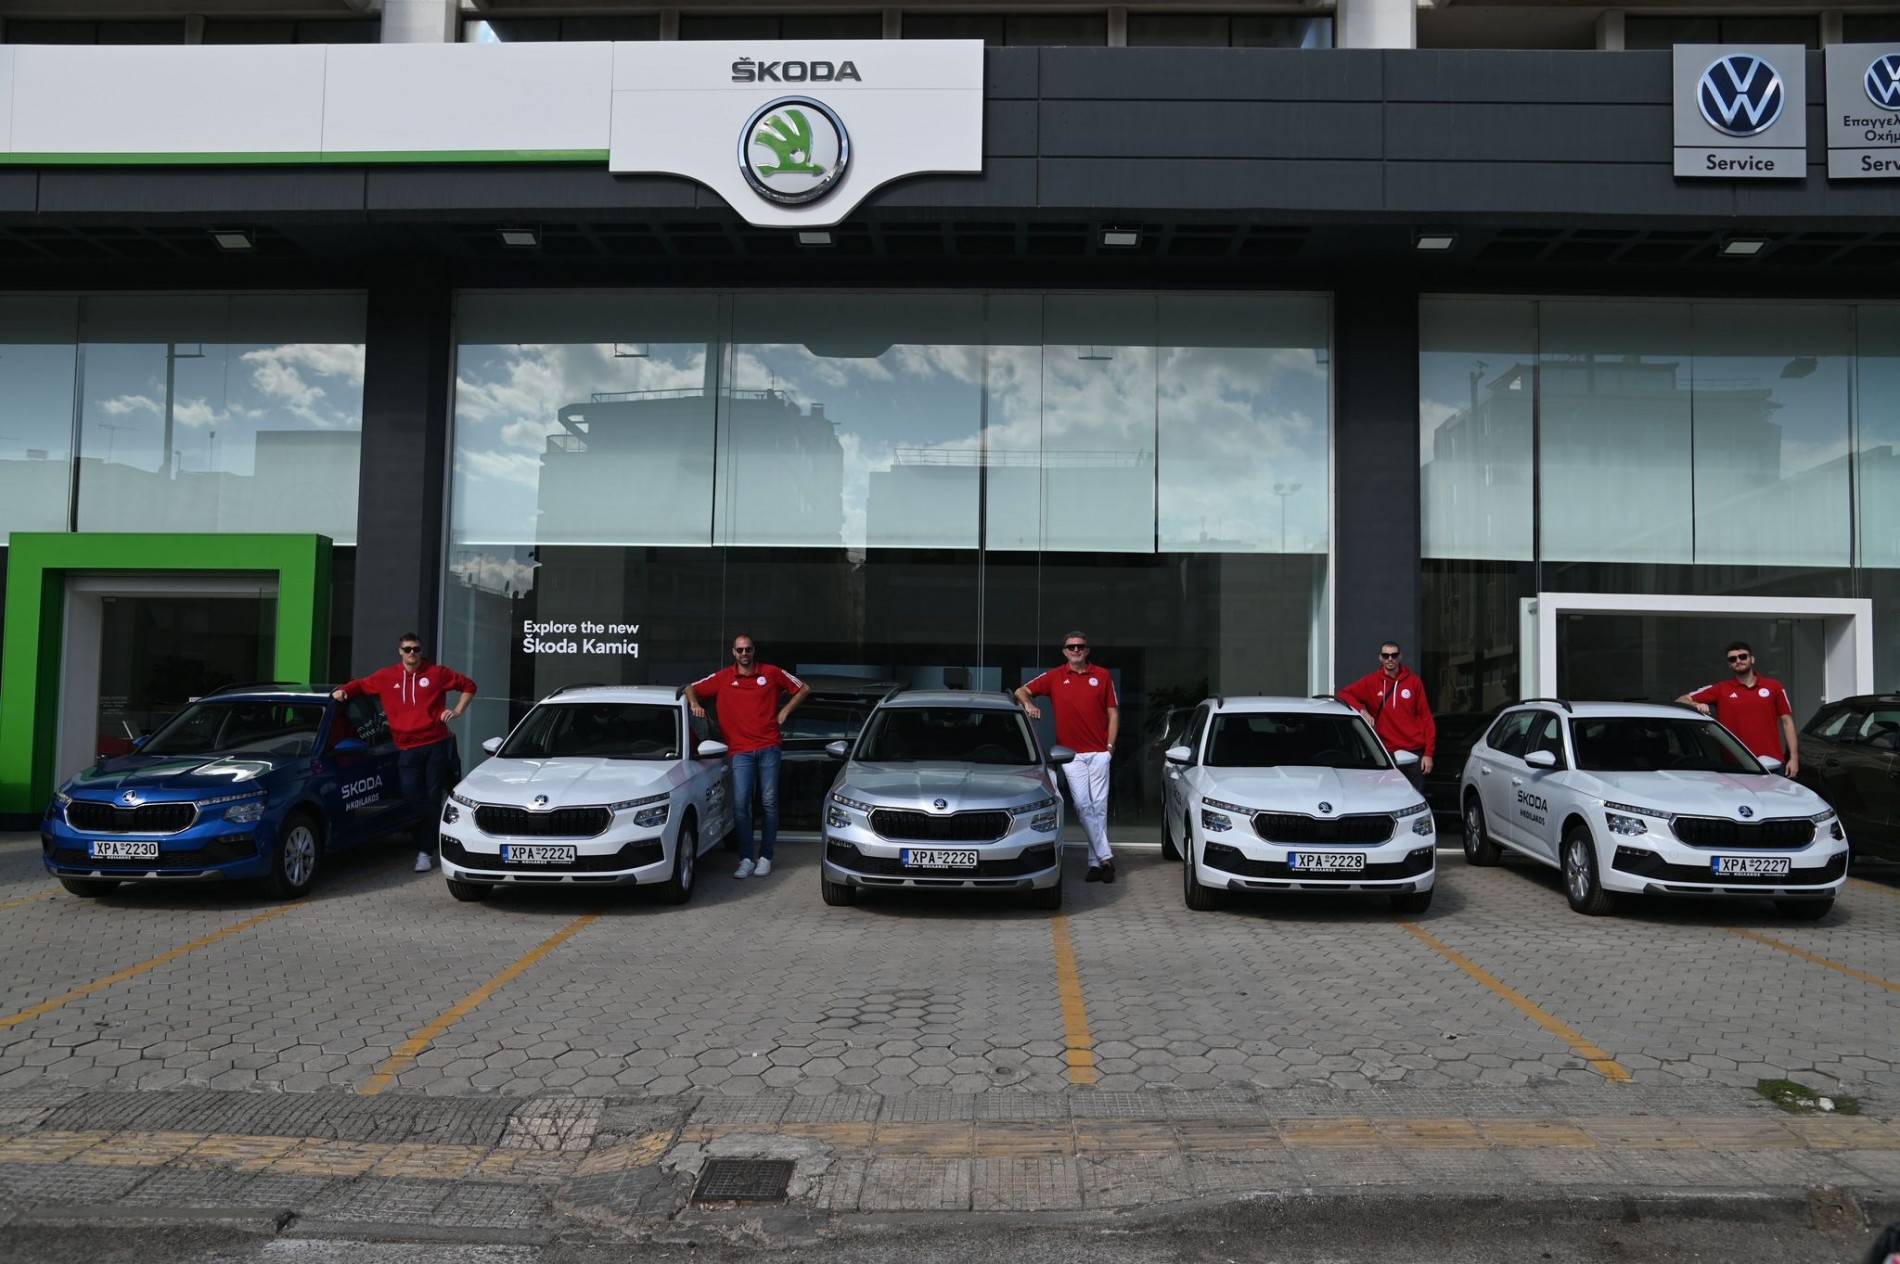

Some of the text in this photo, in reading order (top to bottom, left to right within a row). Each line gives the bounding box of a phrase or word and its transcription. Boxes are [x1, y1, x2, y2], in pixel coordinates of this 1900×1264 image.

[731, 57, 862, 82] ŠKODA
[1706, 154, 1775, 171] Service
[523, 620, 640, 636] Explore the new
[522, 634, 639, 658] Škoda Kamiq
